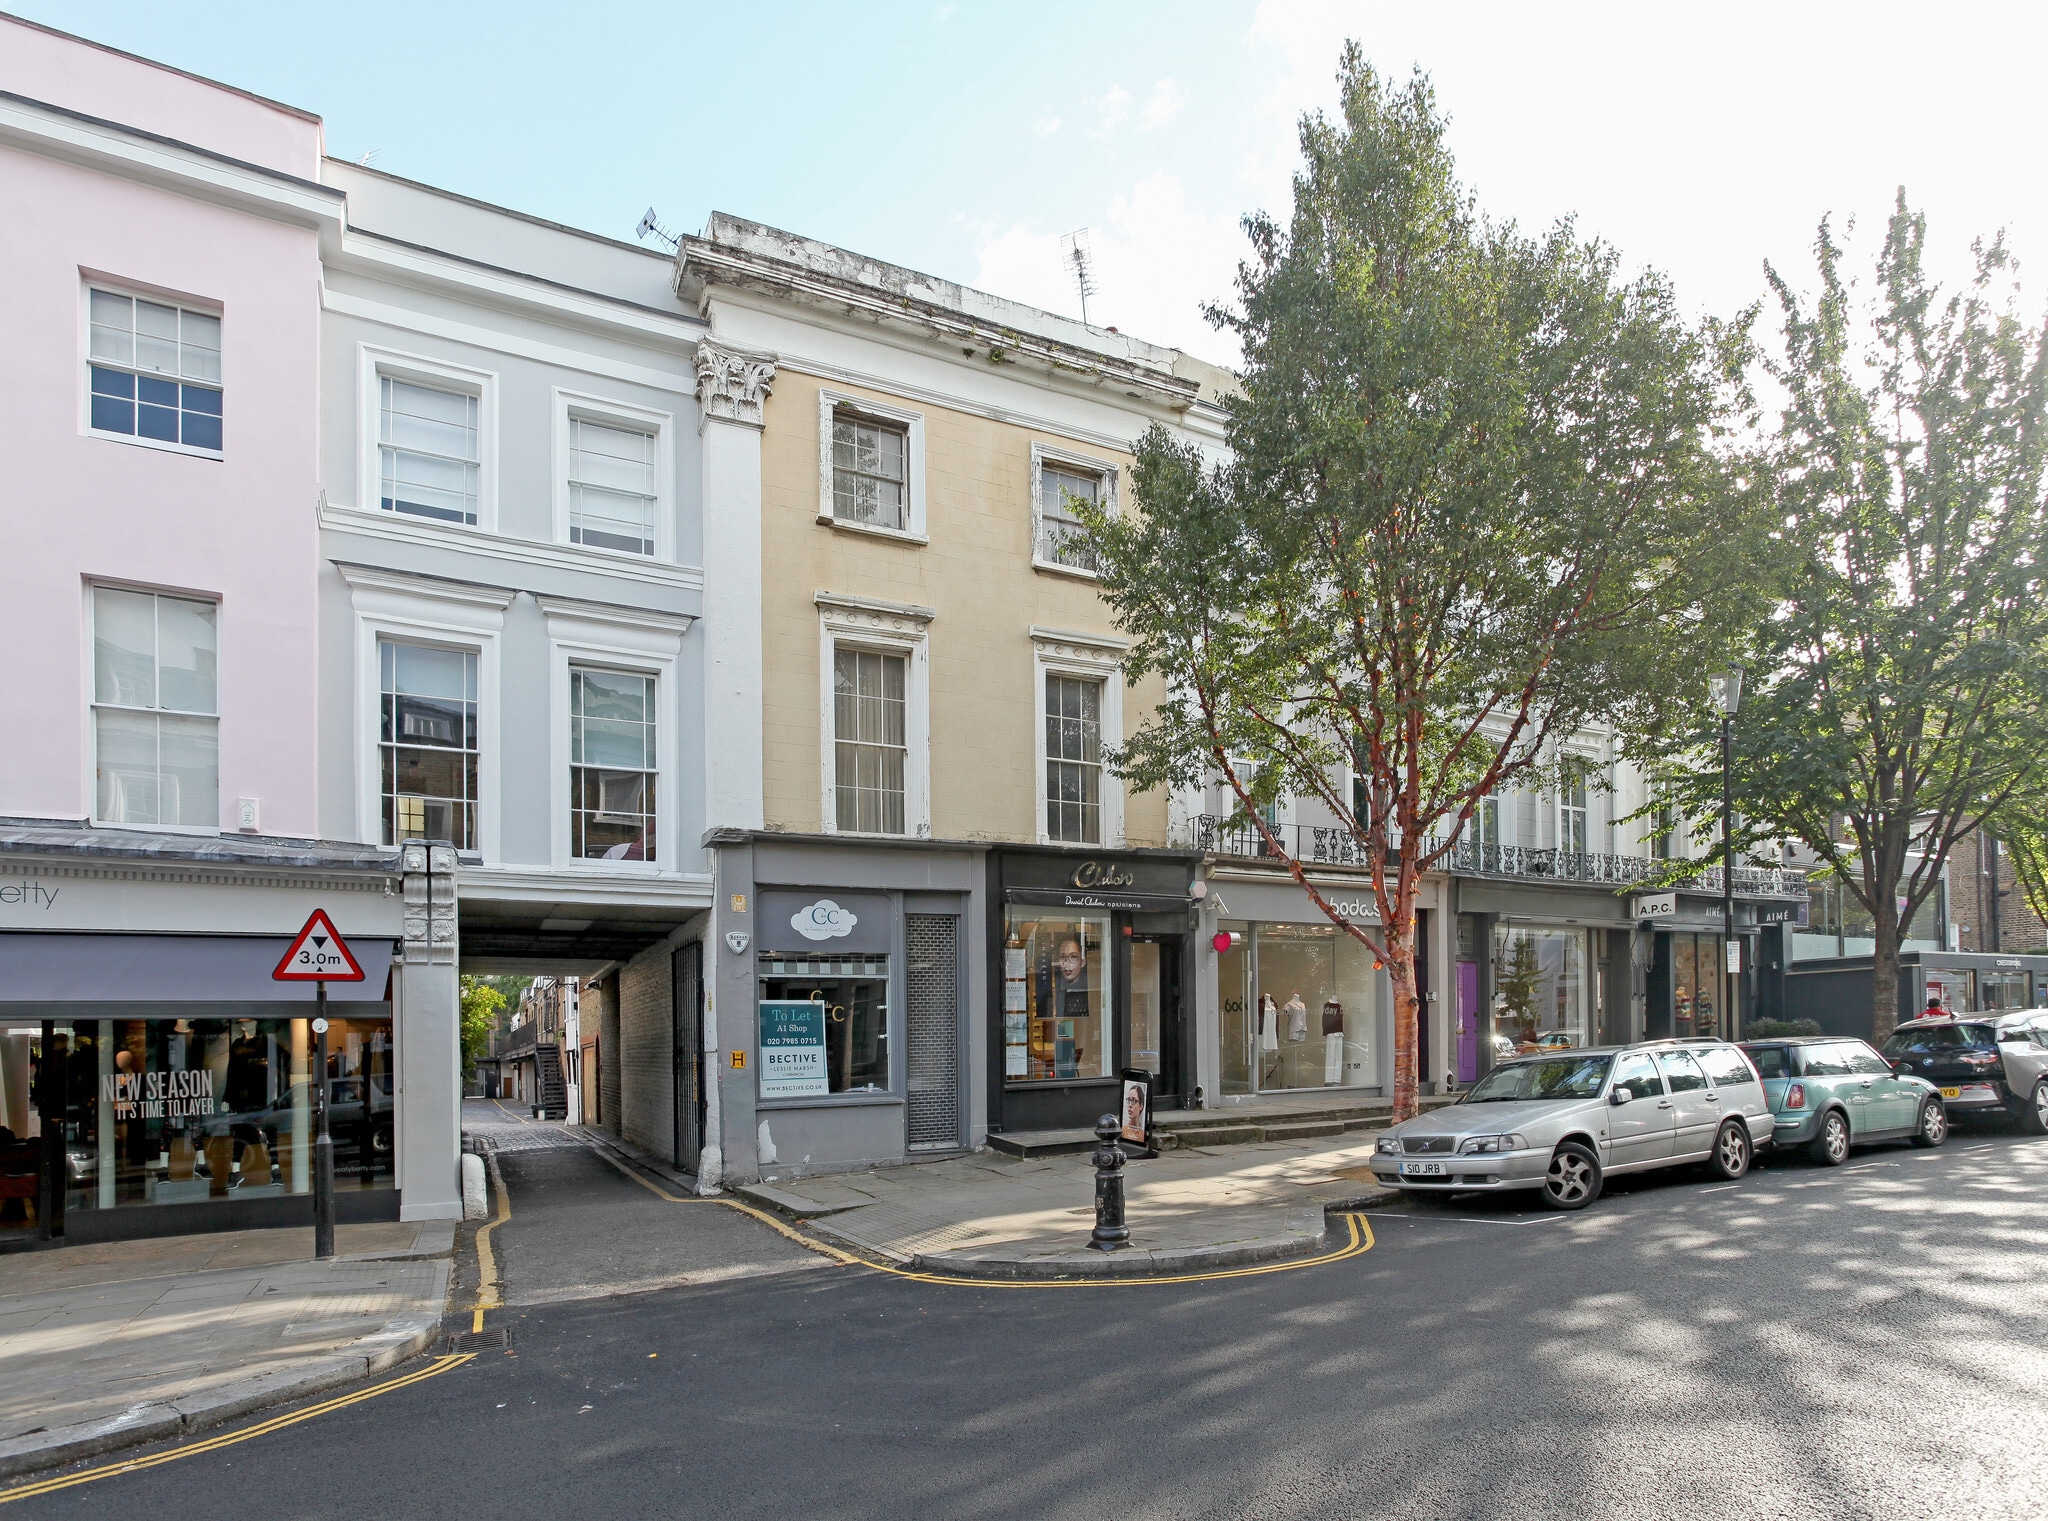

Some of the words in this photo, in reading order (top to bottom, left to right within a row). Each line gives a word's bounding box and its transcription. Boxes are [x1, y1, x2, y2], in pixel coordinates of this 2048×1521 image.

[1065, 896, 1084, 905] David
[1640, 903, 1672, 915] A.P.C.
[1705, 905, 1721, 918] AIMÉ
[1766, 910, 1789, 922] AIMÉ
[299, 951, 341, 965] 3.0m
[772, 1009, 787, 1021] To
[792, 1009, 811, 1021] Let
[789, 1024, 807, 1033] Shop
[732, 1053, 744, 1066] H
[769, 1054, 817, 1063] BECTIVE
[102, 1073, 142, 1102] NEW
[146, 1069, 213, 1100] SEASON
[766, 1084, 823, 1092] WWW.BECTIVE.CO.UK
[117, 1101, 137, 1120] IT'S
[139, 1100, 165, 1119] TIME
[167, 1099, 180, 1117] TO
[183, 1097, 214, 1116] LAYER
[1407, 1164, 1421, 1174] S10
[1422, 1164, 1440, 1174] JRB
